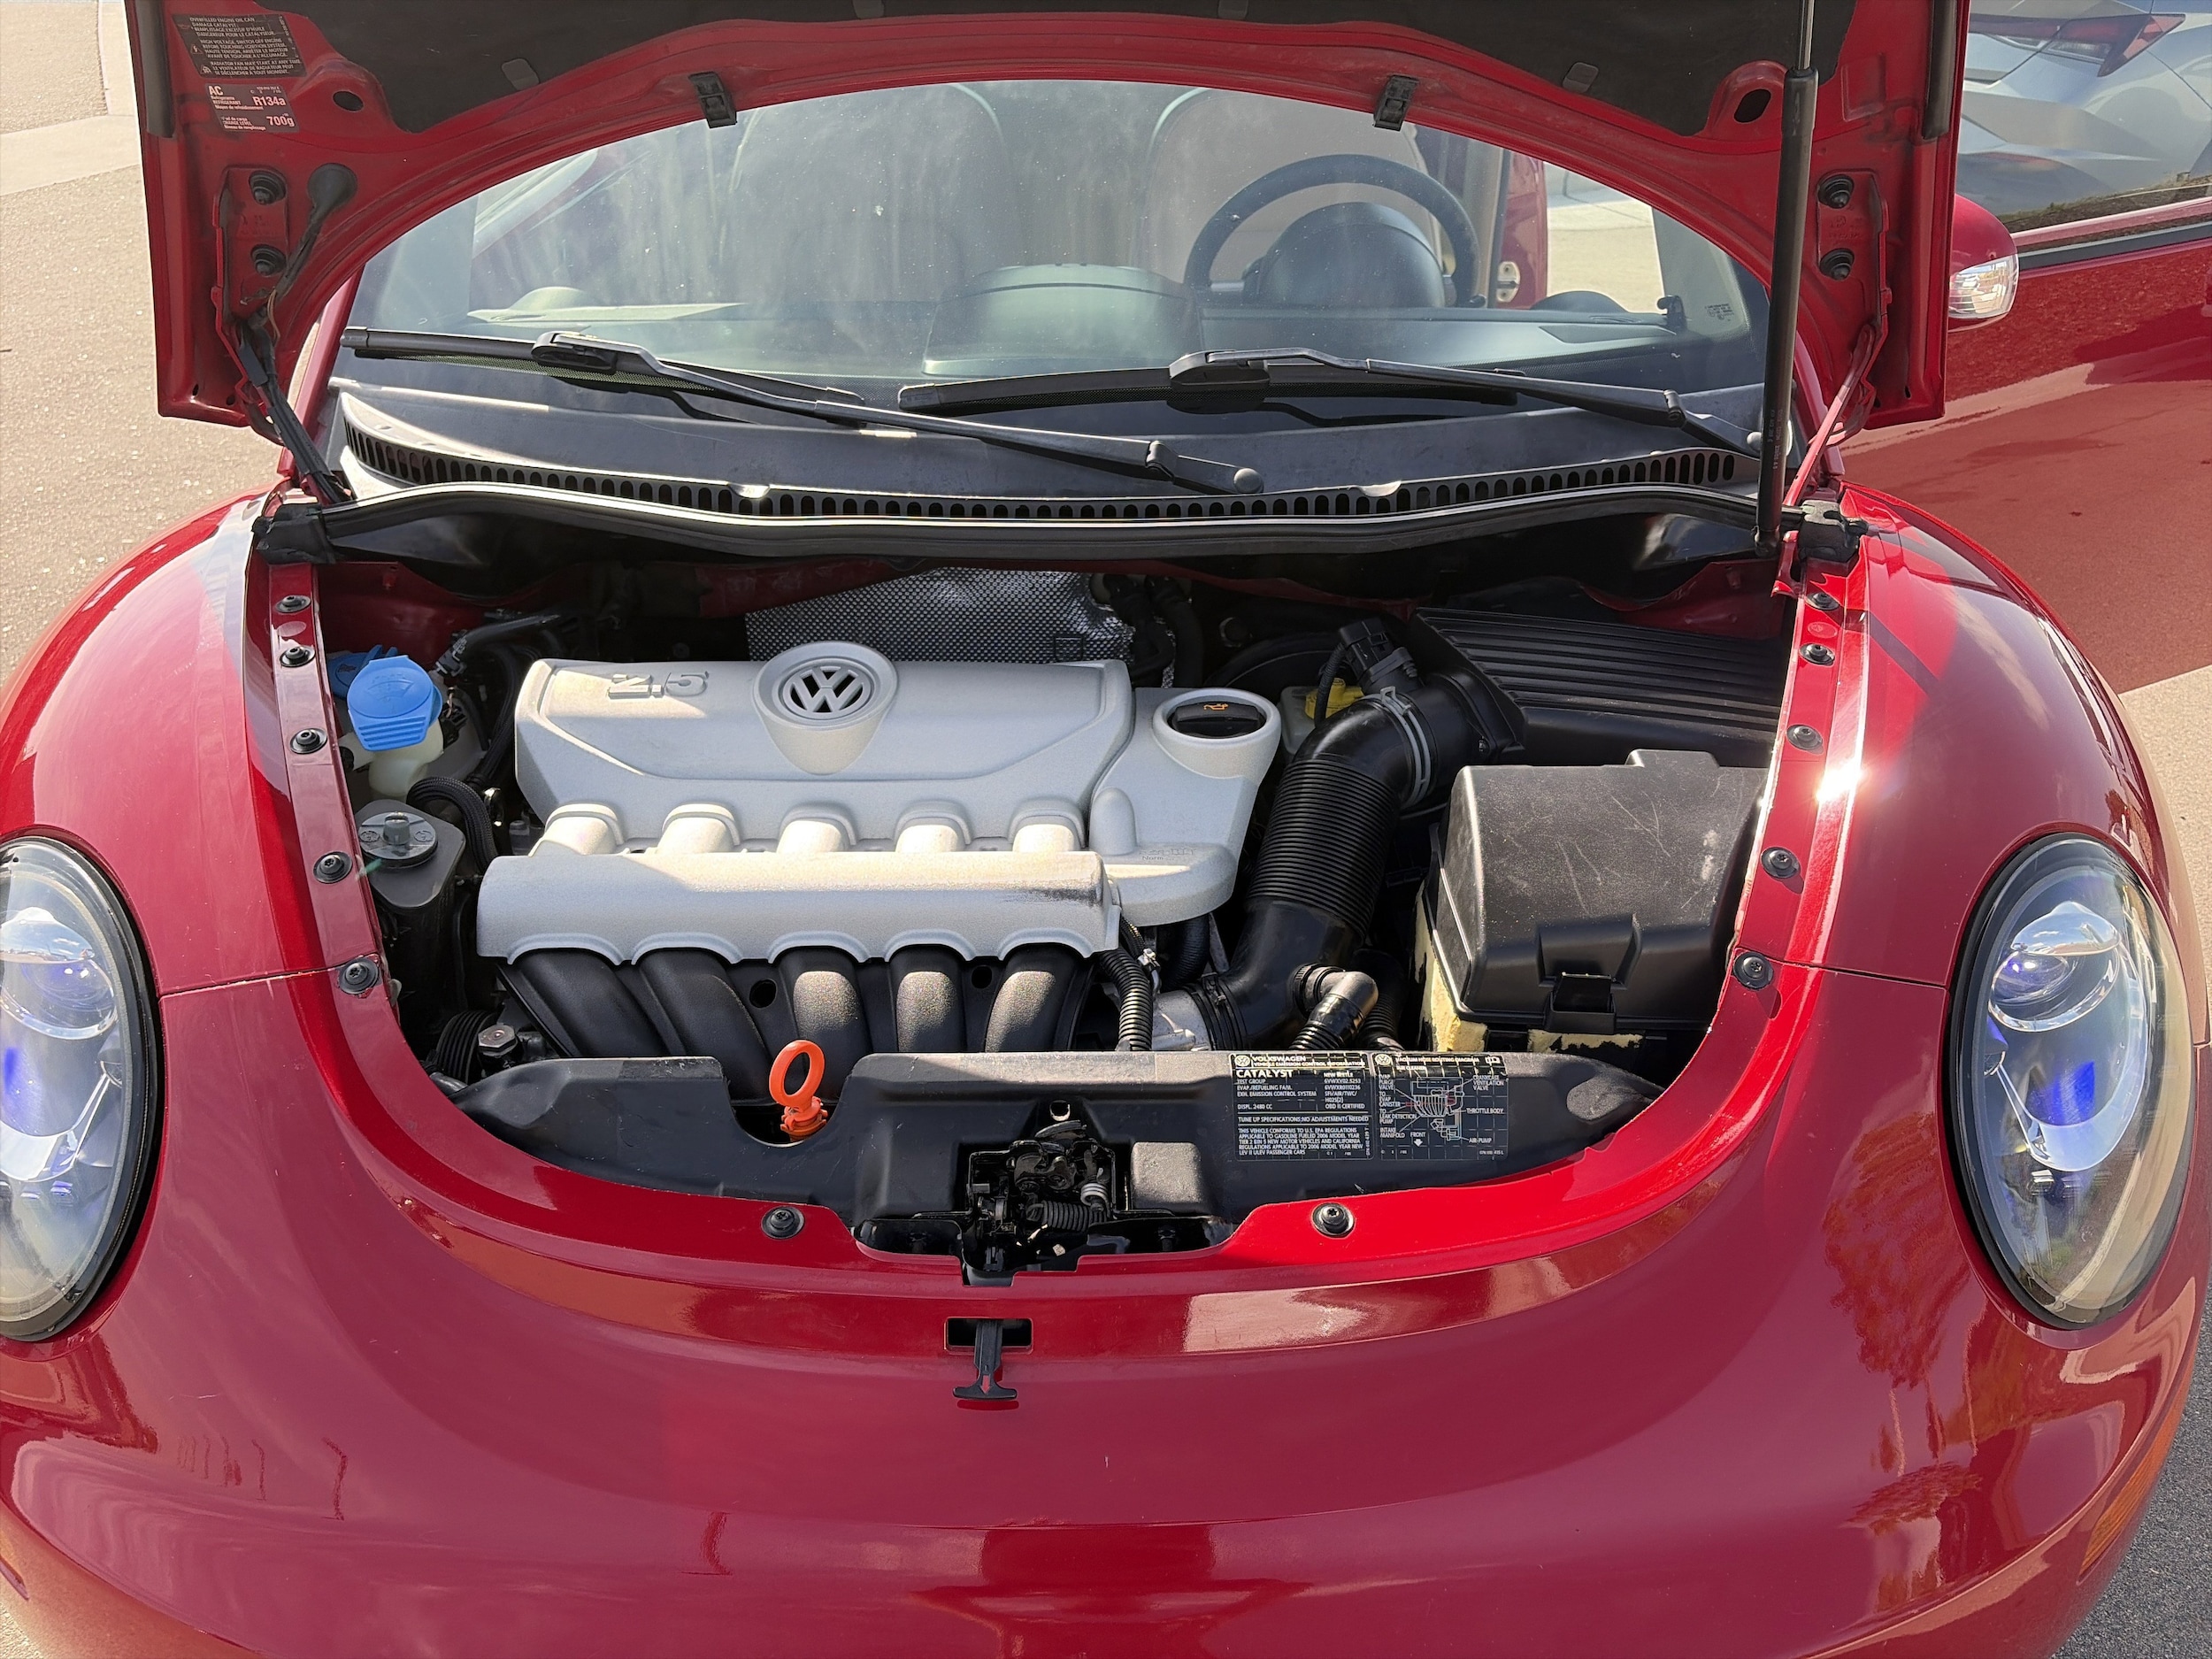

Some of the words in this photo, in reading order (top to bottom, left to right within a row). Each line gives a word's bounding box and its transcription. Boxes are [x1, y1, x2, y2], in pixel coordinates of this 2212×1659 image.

[208, 86, 223, 95] AC
[252, 96, 286, 106] R134a
[266, 116, 296, 127] 700g
[607, 671, 709, 699] 2.5
